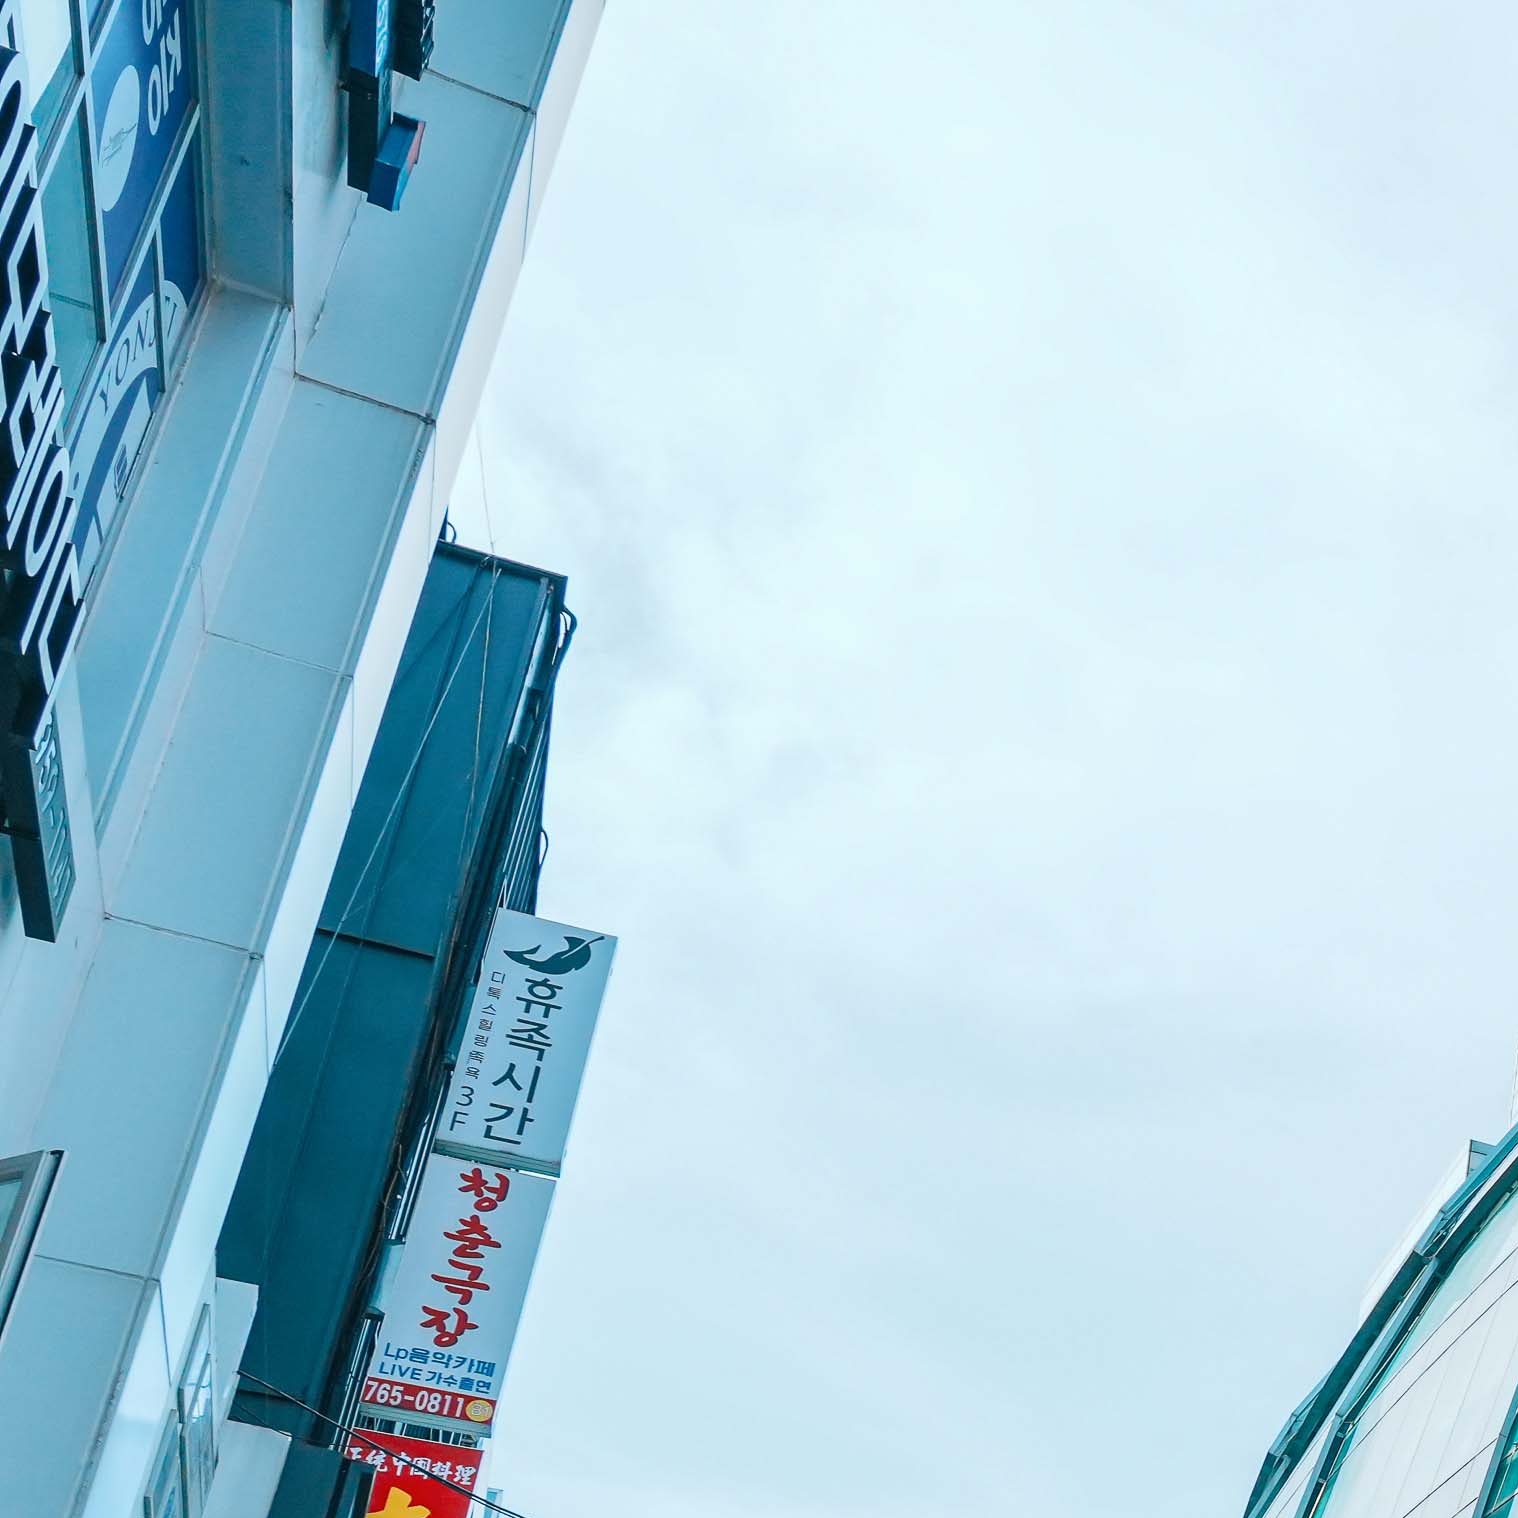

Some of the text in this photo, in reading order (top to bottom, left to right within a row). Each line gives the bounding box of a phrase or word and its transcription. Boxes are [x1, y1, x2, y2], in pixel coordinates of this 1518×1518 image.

[484, 977, 564, 1145] 휴족시간
[420, 1167, 510, 1348] 청춘극장
[379, 1362, 492, 1394] LIVE 가수출연
[384, 1343, 496, 1378] Lp음악카페
[367, 1380, 464, 1417] 765-0811
